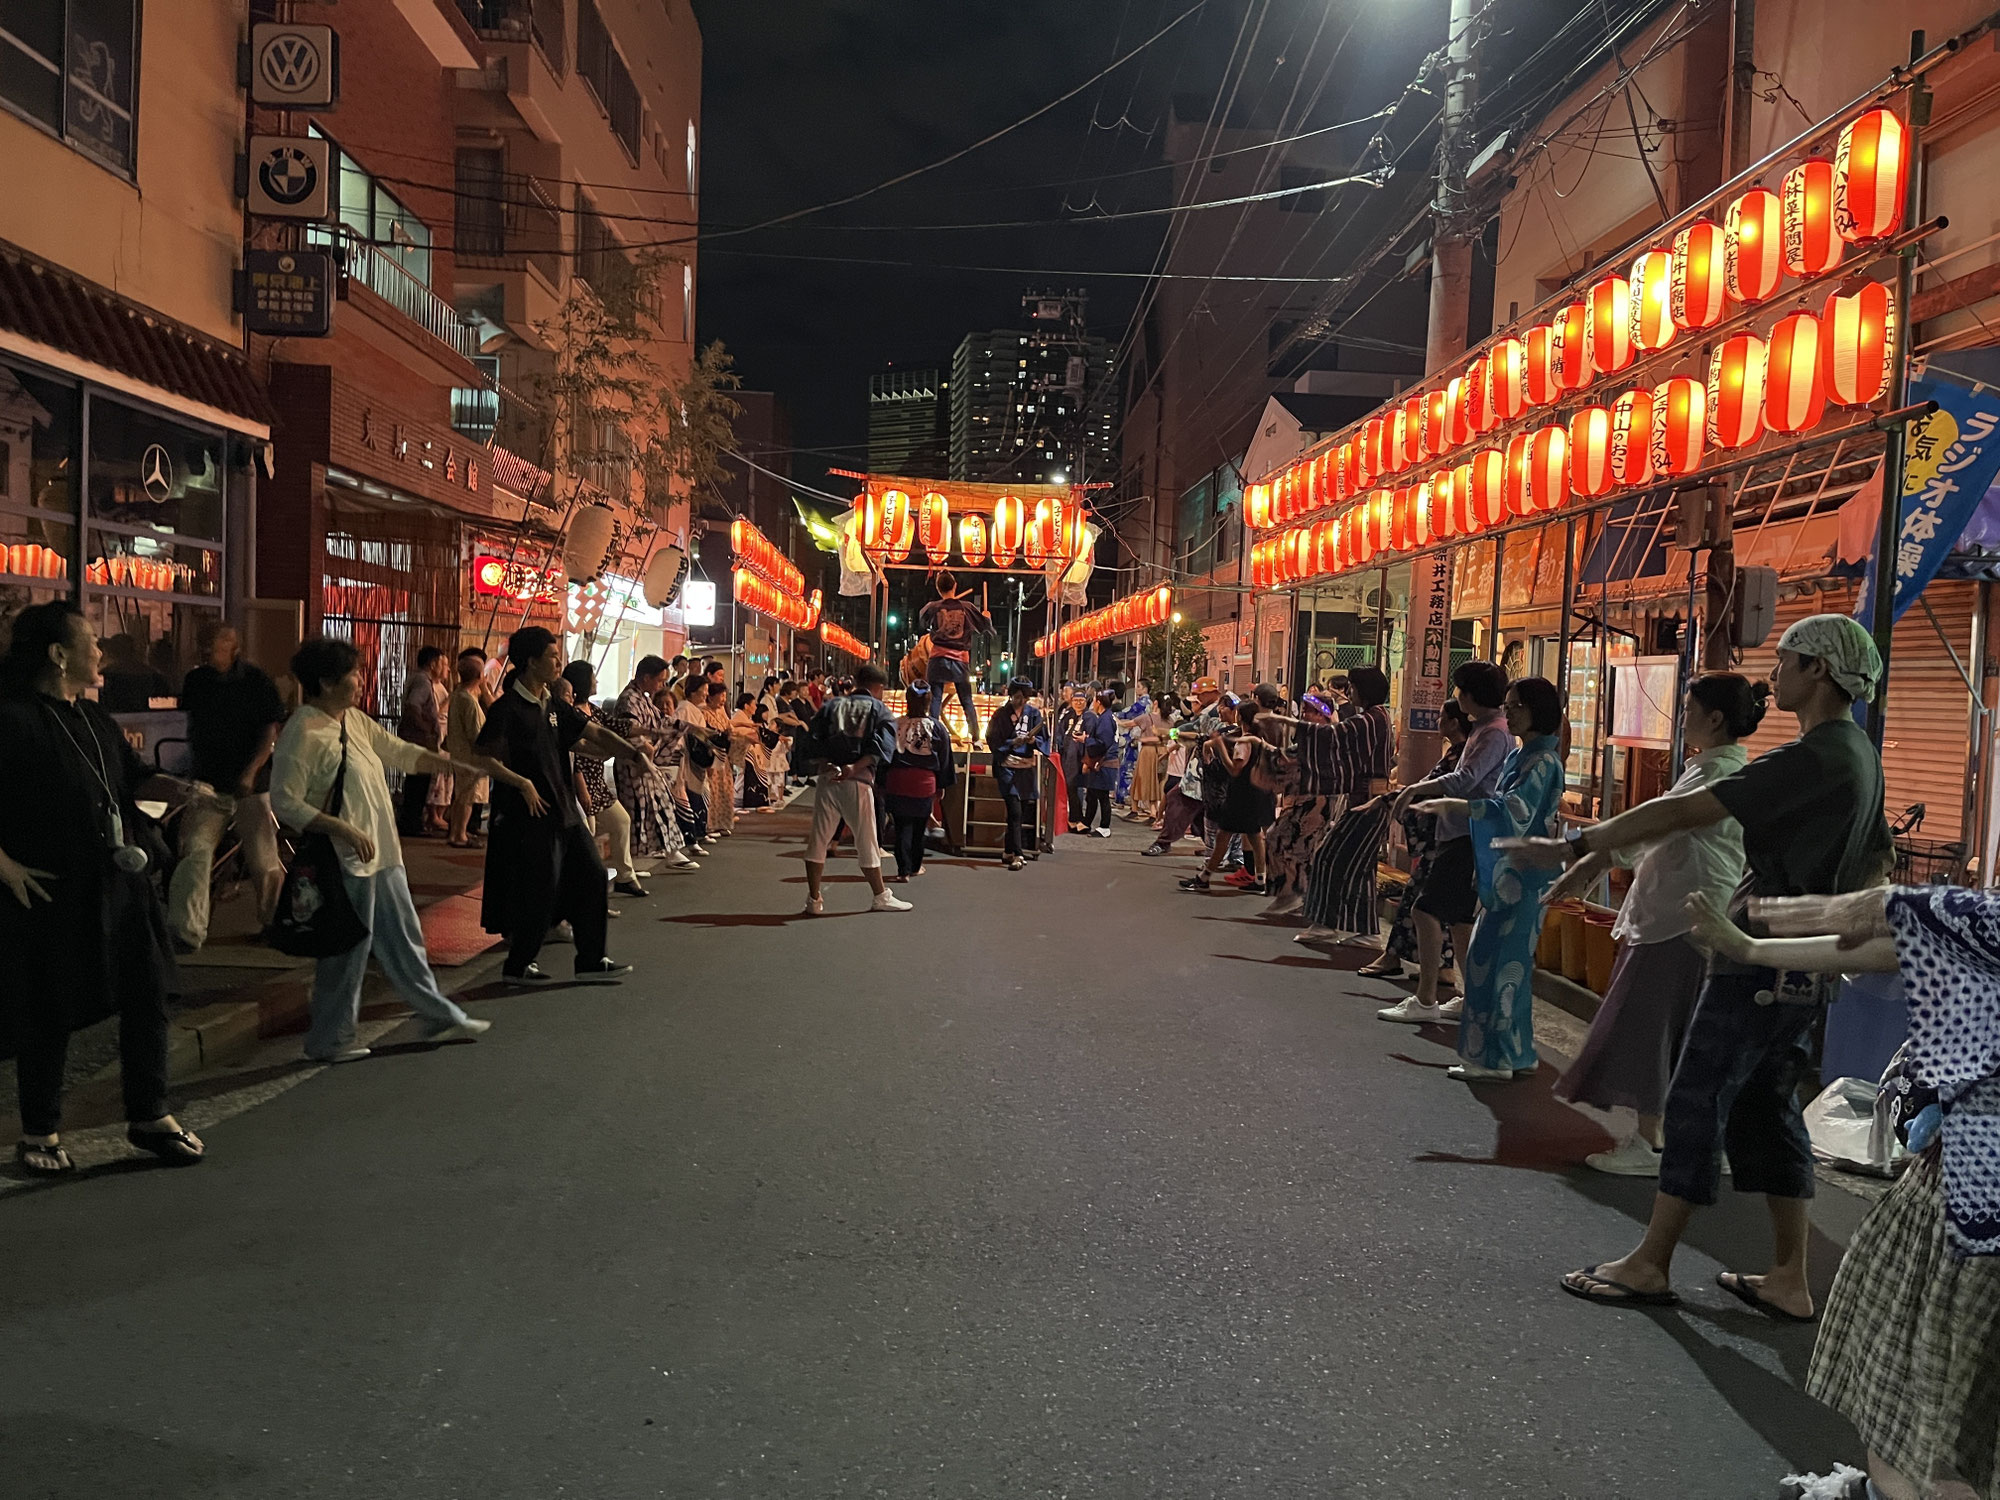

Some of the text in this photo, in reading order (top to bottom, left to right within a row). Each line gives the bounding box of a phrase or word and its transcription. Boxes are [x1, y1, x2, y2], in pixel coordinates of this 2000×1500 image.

[263, 146, 313, 169] BMW
[1611, 400, 1634, 480] 中山のおこし
[1903, 414, 1940, 491] お気に
